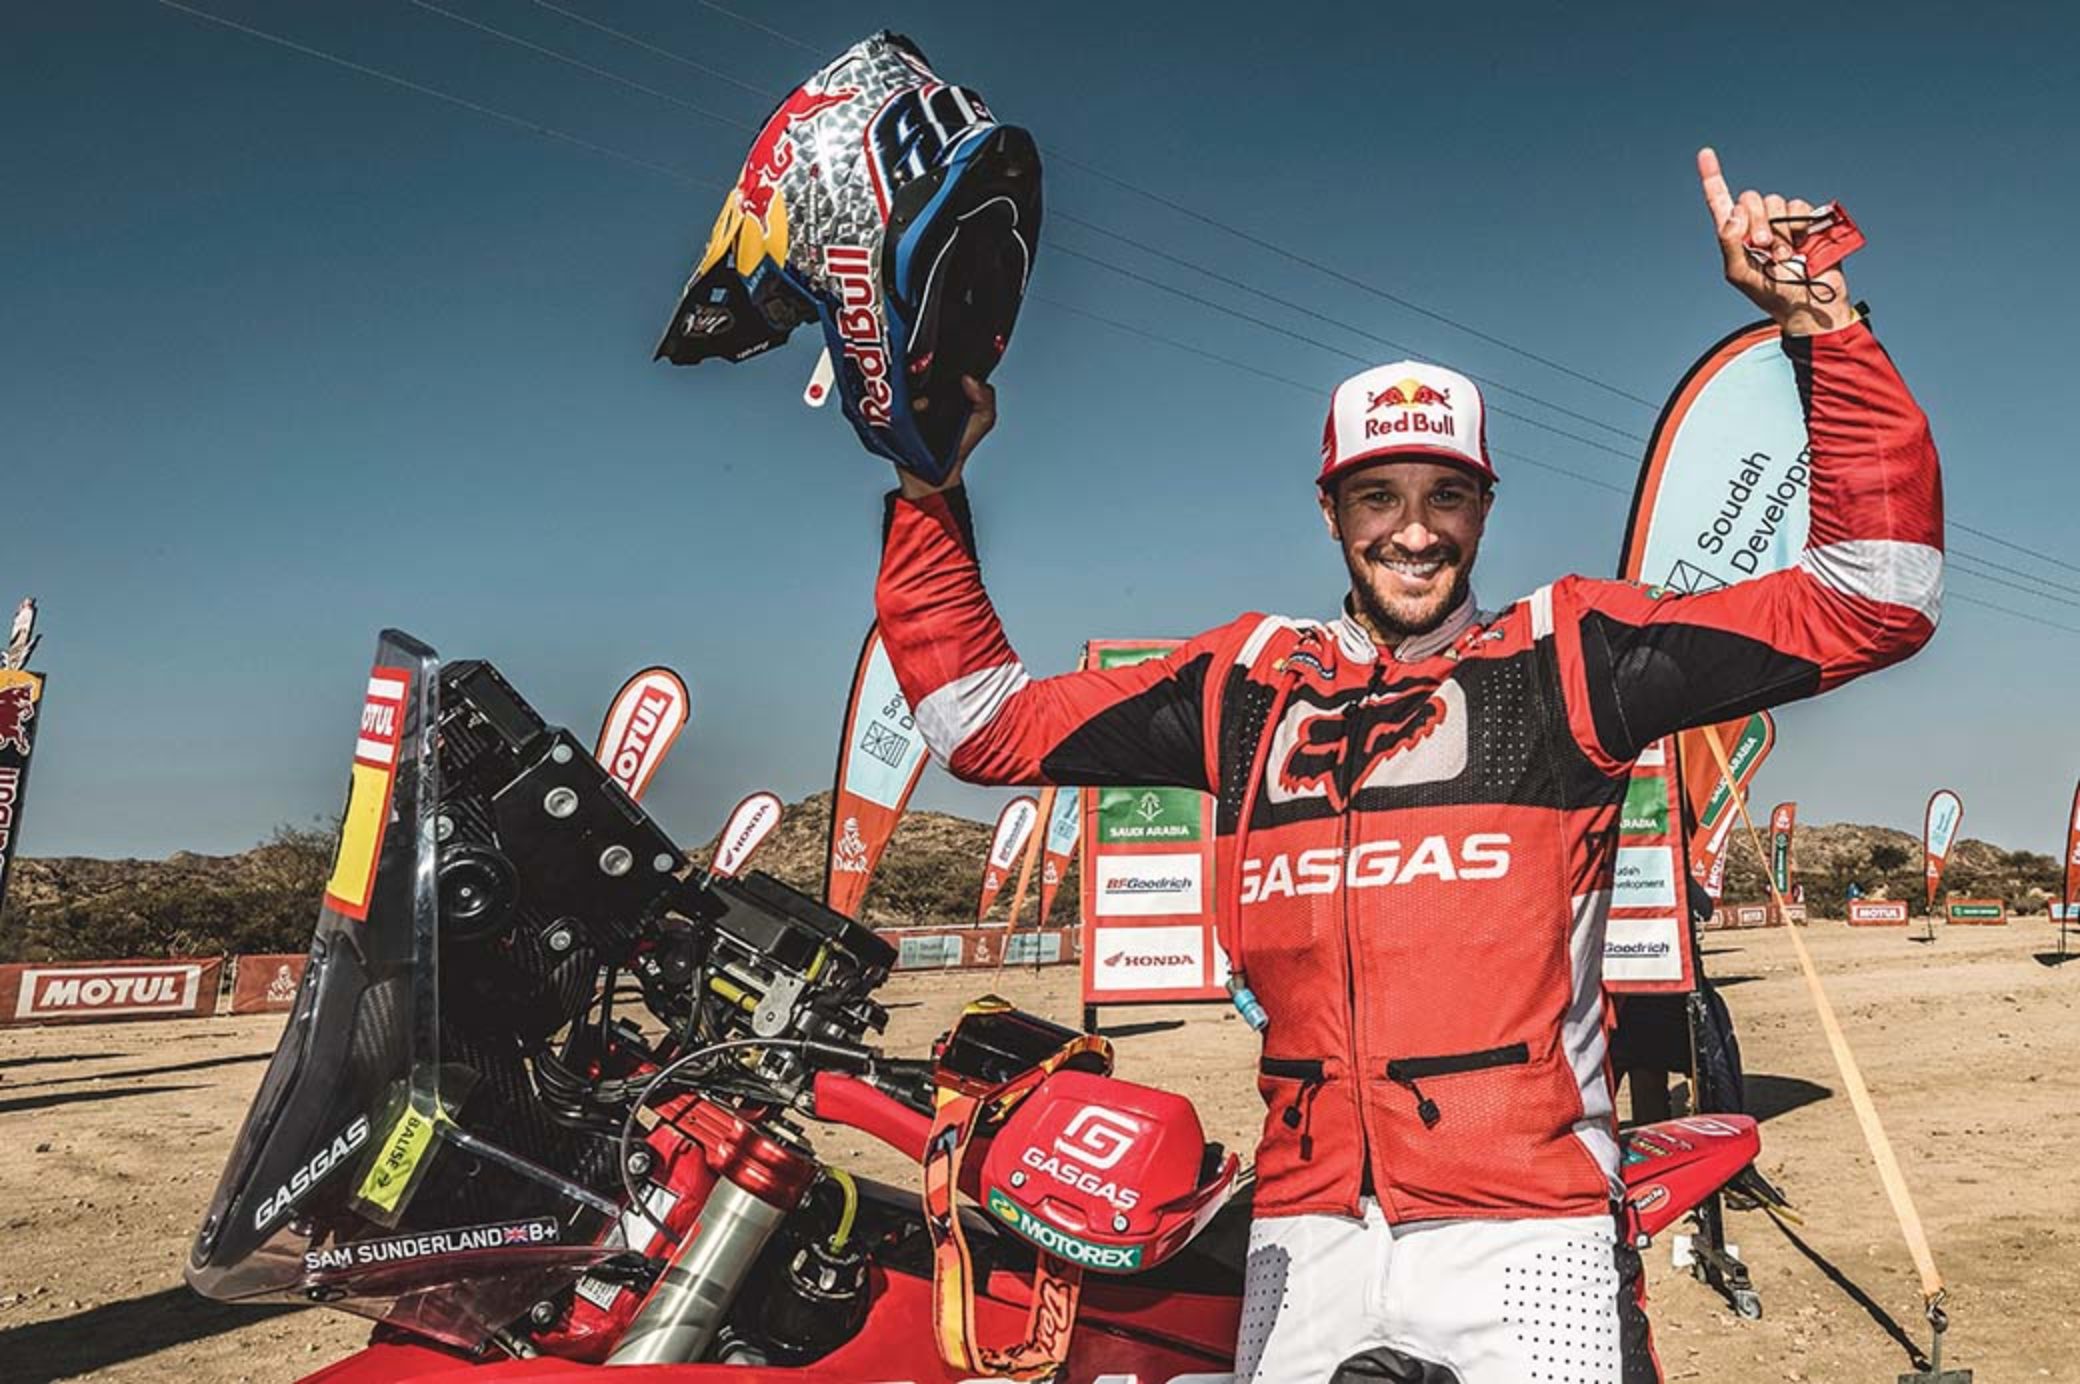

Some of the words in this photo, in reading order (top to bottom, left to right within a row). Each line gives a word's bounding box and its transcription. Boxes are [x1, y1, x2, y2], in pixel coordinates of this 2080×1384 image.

[824, 245, 880, 342] Bull
[843, 343, 892, 428] Red
[1365, 411, 1410, 439] Red
[1413, 412, 1455, 437] Bull
[1697, 451, 1771, 555] Soudah
[361, 703, 395, 736] OTUL
[733, 803, 770, 852] HONDA
[1109, 826, 1144, 837] SAUDI
[1146, 825, 1190, 837] ARABIA
[1105, 877, 1192, 889] BFGoodrich
[1616, 879, 1665, 891] velopment
[1859, 909, 1897, 918] MOTUL
[1125, 955, 1195, 967] HONDA
[1604, 941, 1669, 953] Goodrich
[39, 976, 179, 1007] MOTUL
[386, 1117, 421, 1170] BALISE
[255, 1117, 368, 1231] GASGAS
[1022, 1147, 1140, 1210] GASGAS
[305, 1247, 353, 1270] SAM
[359, 1227, 501, 1263] SUNDERLAND
[529, 1223, 557, 1241] B+
[1020, 1213, 1134, 1268] MOTOREX
